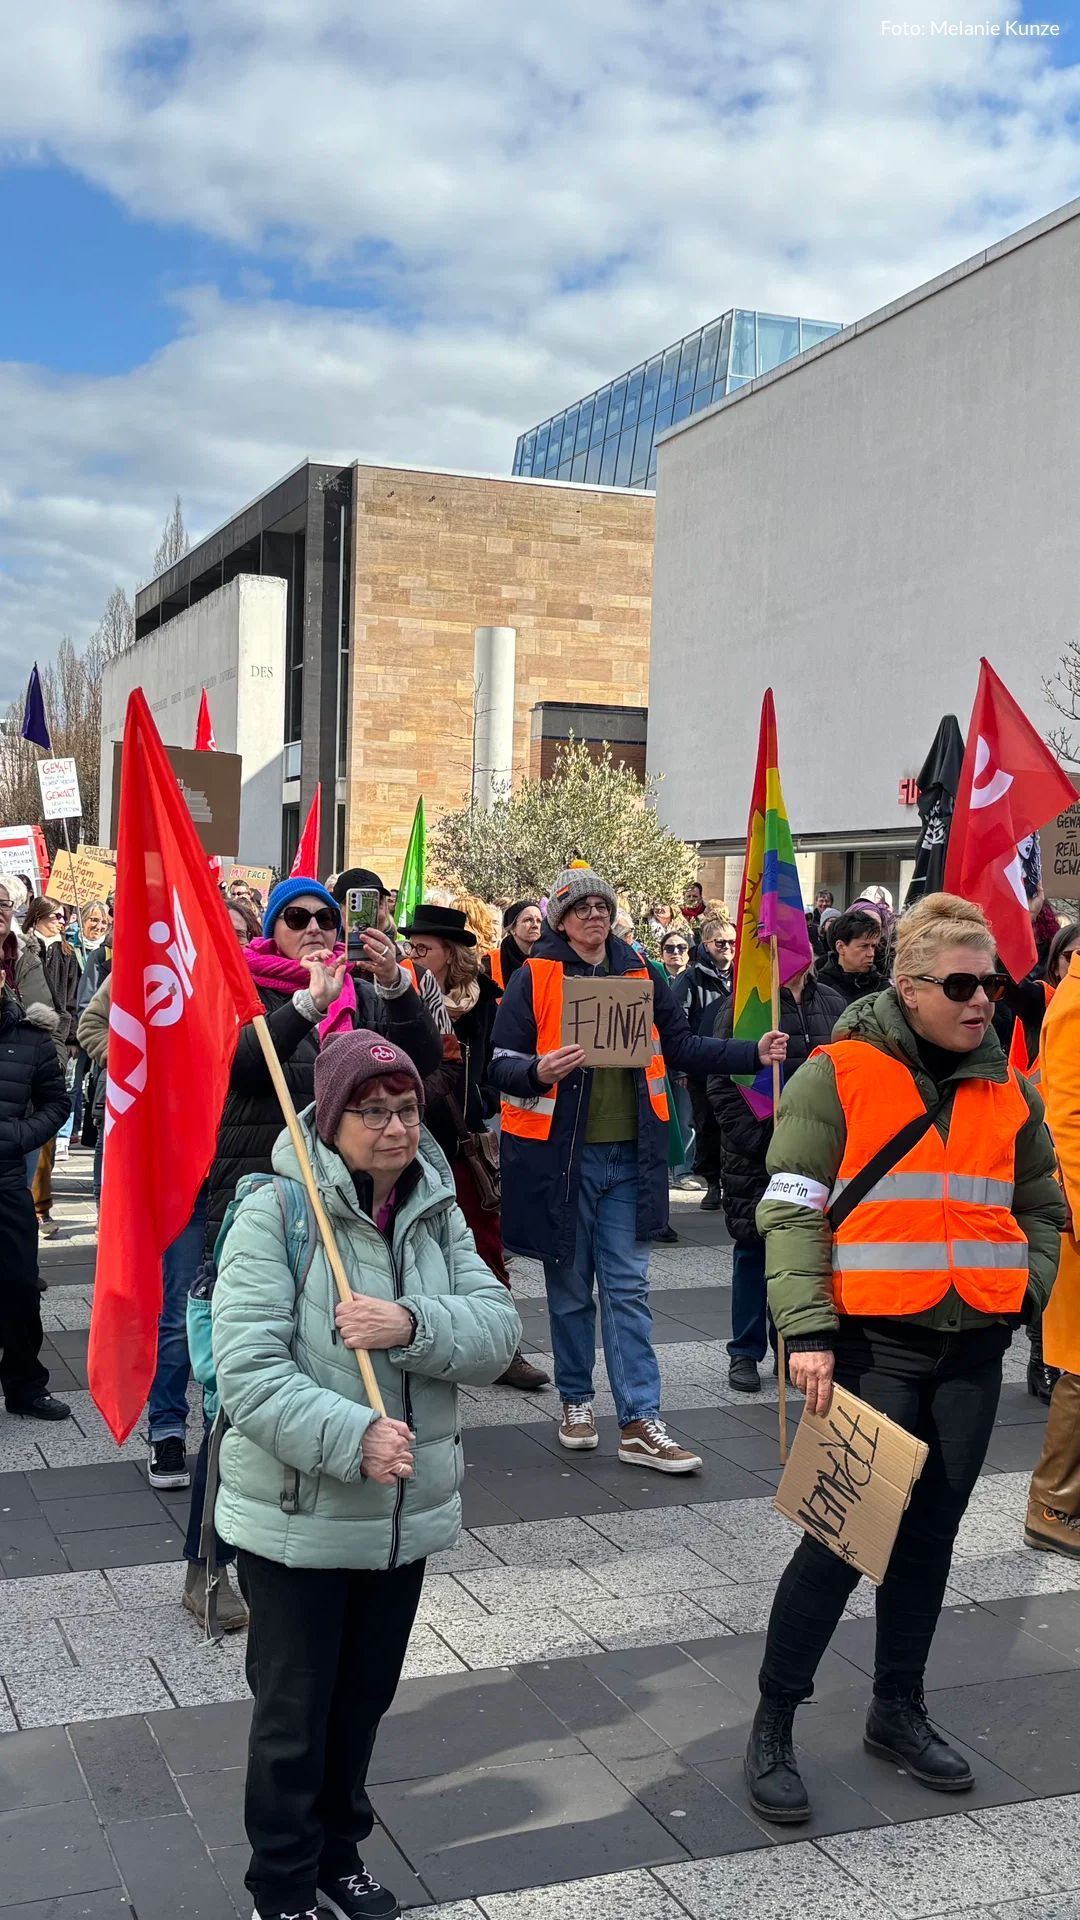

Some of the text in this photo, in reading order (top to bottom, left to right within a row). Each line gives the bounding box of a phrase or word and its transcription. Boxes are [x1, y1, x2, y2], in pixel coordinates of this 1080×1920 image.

[251, 665, 274, 679] DES
[898, 778, 918, 804] SU
[84, 846, 108, 858] CHECK
[247, 870, 267, 880] FACE
